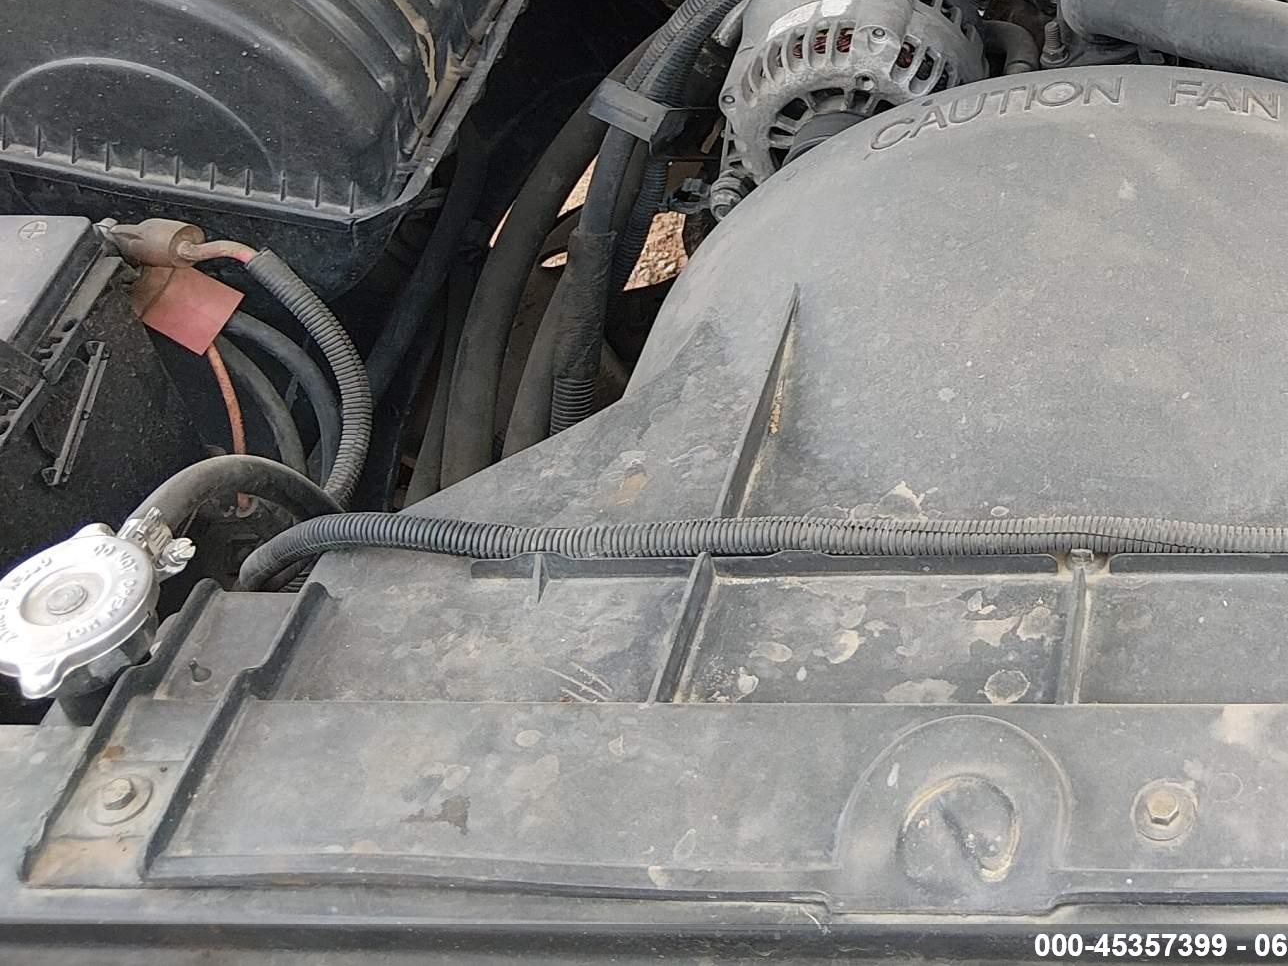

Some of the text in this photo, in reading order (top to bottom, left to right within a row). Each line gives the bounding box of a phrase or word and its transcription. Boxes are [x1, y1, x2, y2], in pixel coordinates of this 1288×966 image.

[870, 76, 1280, 151] CAUTION FAN
[119, 550, 139, 573] NOT
